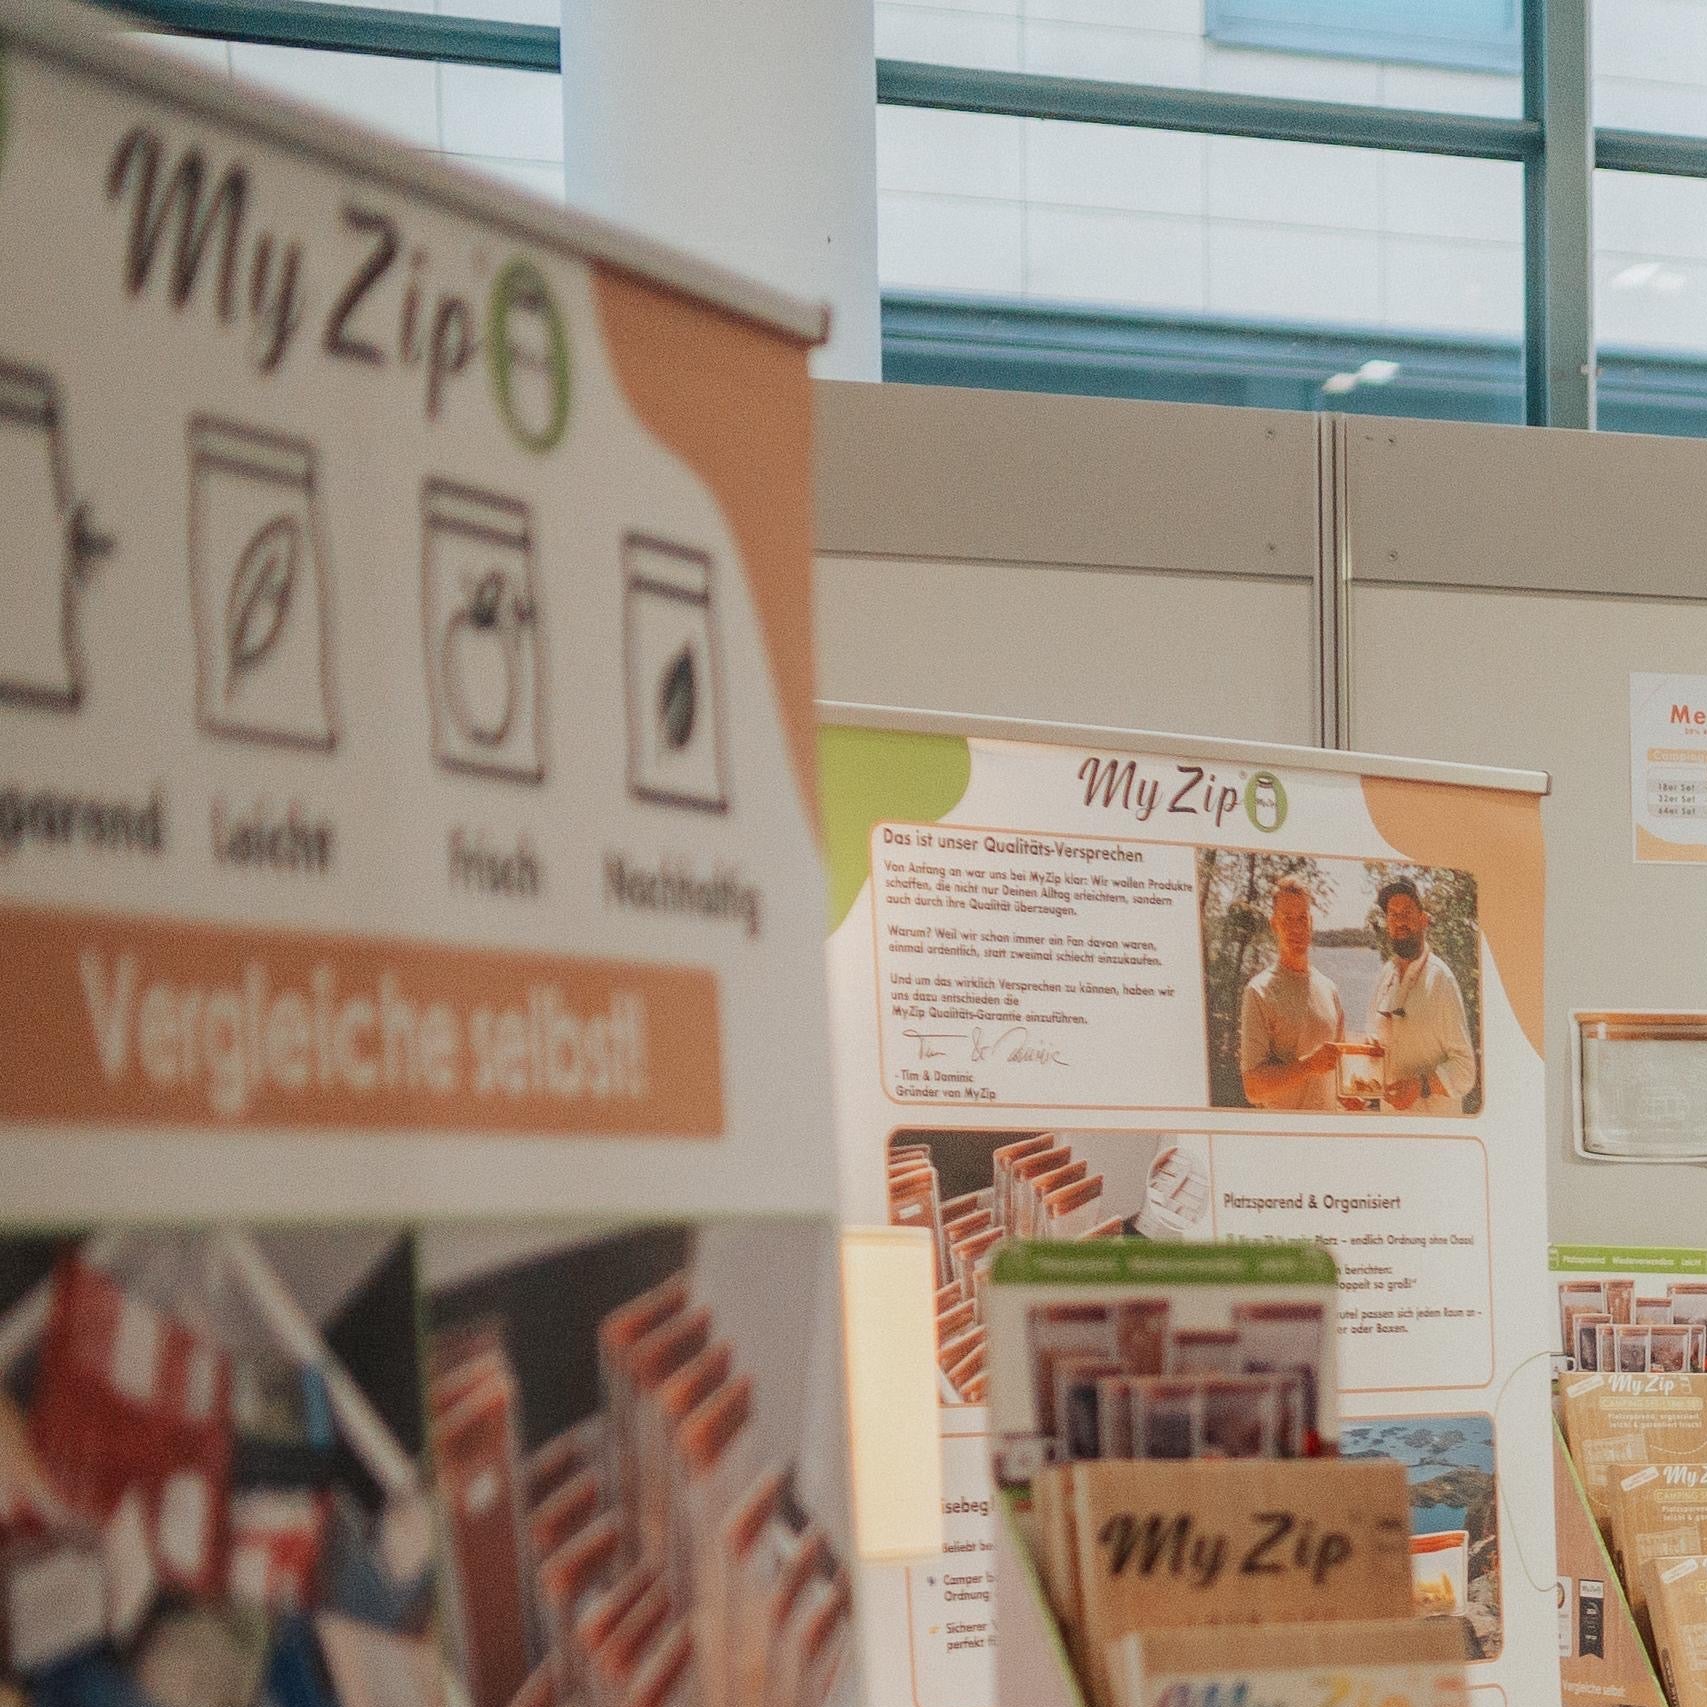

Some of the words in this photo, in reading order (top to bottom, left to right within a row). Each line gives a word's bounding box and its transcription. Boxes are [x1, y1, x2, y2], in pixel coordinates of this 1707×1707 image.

[883, 827, 912, 847] Das
[916, 829, 933, 848] ist
[938, 837, 979, 851] unser
[983, 836, 1144, 864] Qualitäts-Versprechen
[884, 860, 905, 873] Von
[908, 862, 946, 878] Anfang
[949, 867, 962, 878] an
[966, 868, 986, 879] war
[989, 870, 1008, 881] uns
[1009, 868, 1027, 882] bei
[1029, 871, 1062, 886] MyZip
[1064, 871, 1088, 886] klar:
[1090, 874, 1108, 887] Wir
[1112, 876, 1145, 889] wollen
[1148, 879, 1193, 892] Produkte
[885, 876, 932, 891] schaffen,
[935, 878, 951, 892] die
[954, 881, 978, 894] nicht
[981, 885, 999, 896] nur
[1002, 884, 1038, 898] Deinen
[1040, 887, 1071, 903] Alltag
[1132, 893, 1173, 906] sondern
[886, 893, 911, 906] auch
[914, 895, 943, 907] durch
[946, 896, 966, 909] ihre
[969, 898, 1012, 912] Qualität
[1014, 902, 1077, 918] überzeugen.
[887, 924, 932, 938] Warum?
[935, 927, 957, 940] Weil
[960, 929, 977, 942] wir
[980, 930, 1010, 944] schon
[1013, 932, 1045, 945] immer
[1049, 934, 1063, 946] ein
[1066, 935, 1084, 947] Fan
[1087, 936, 1119, 948] davon
[1122, 941, 1157, 952] waren,
[888, 940, 924, 954] einmal
[983, 947, 1007, 958] statt
[1010, 947, 1053, 961] zweimal
[1056, 949, 1094, 963] schlecht
[890, 972, 912, 985] Und
[915, 976, 931, 986] um
[934, 974, 952, 987] das
[955, 976, 995, 989] wirklich
[998, 978, 1062, 993] Versprechen
[1065, 983, 1076, 993] zu
[1123, 982, 1155, 996] haben
[1158, 984, 1176, 997] wir
[891, 991, 909, 1001] uns
[912, 989, 938, 1002] dazu
[941, 991, 1000, 1005] entschieden
[1003, 993, 1020, 1006] die
[891, 1004, 925, 1019] MyZip
[78, 949, 458, 1118] Vergleiche
[934, 1070, 974, 1083] Dominic
[896, 1086, 939, 1099] Gründer
[943, 1088, 961, 1099] von
[965, 1087, 996, 1102] MyZip
[1224, 1192, 1303, 1214] Platzsparend
[1308, 1194, 1318, 1209] &
[1323, 1193, 1401, 1213] Organisiert
[1350, 1234, 1384, 1246] endlich
[1388, 1234, 1426, 1248] Ordnung
[1429, 1235, 1448, 1246] ohne
[1373, 1280, 1384, 1289] so
[1361, 1310, 1394, 1321] passen
[1350, 1323, 1374, 1335] oder
[1376, 1323, 1409, 1334] Boxen.
[943, 1573, 982, 1587] Camper
[944, 1589, 990, 1602] Ordnung
[946, 1622, 987, 1634] Sicherer
